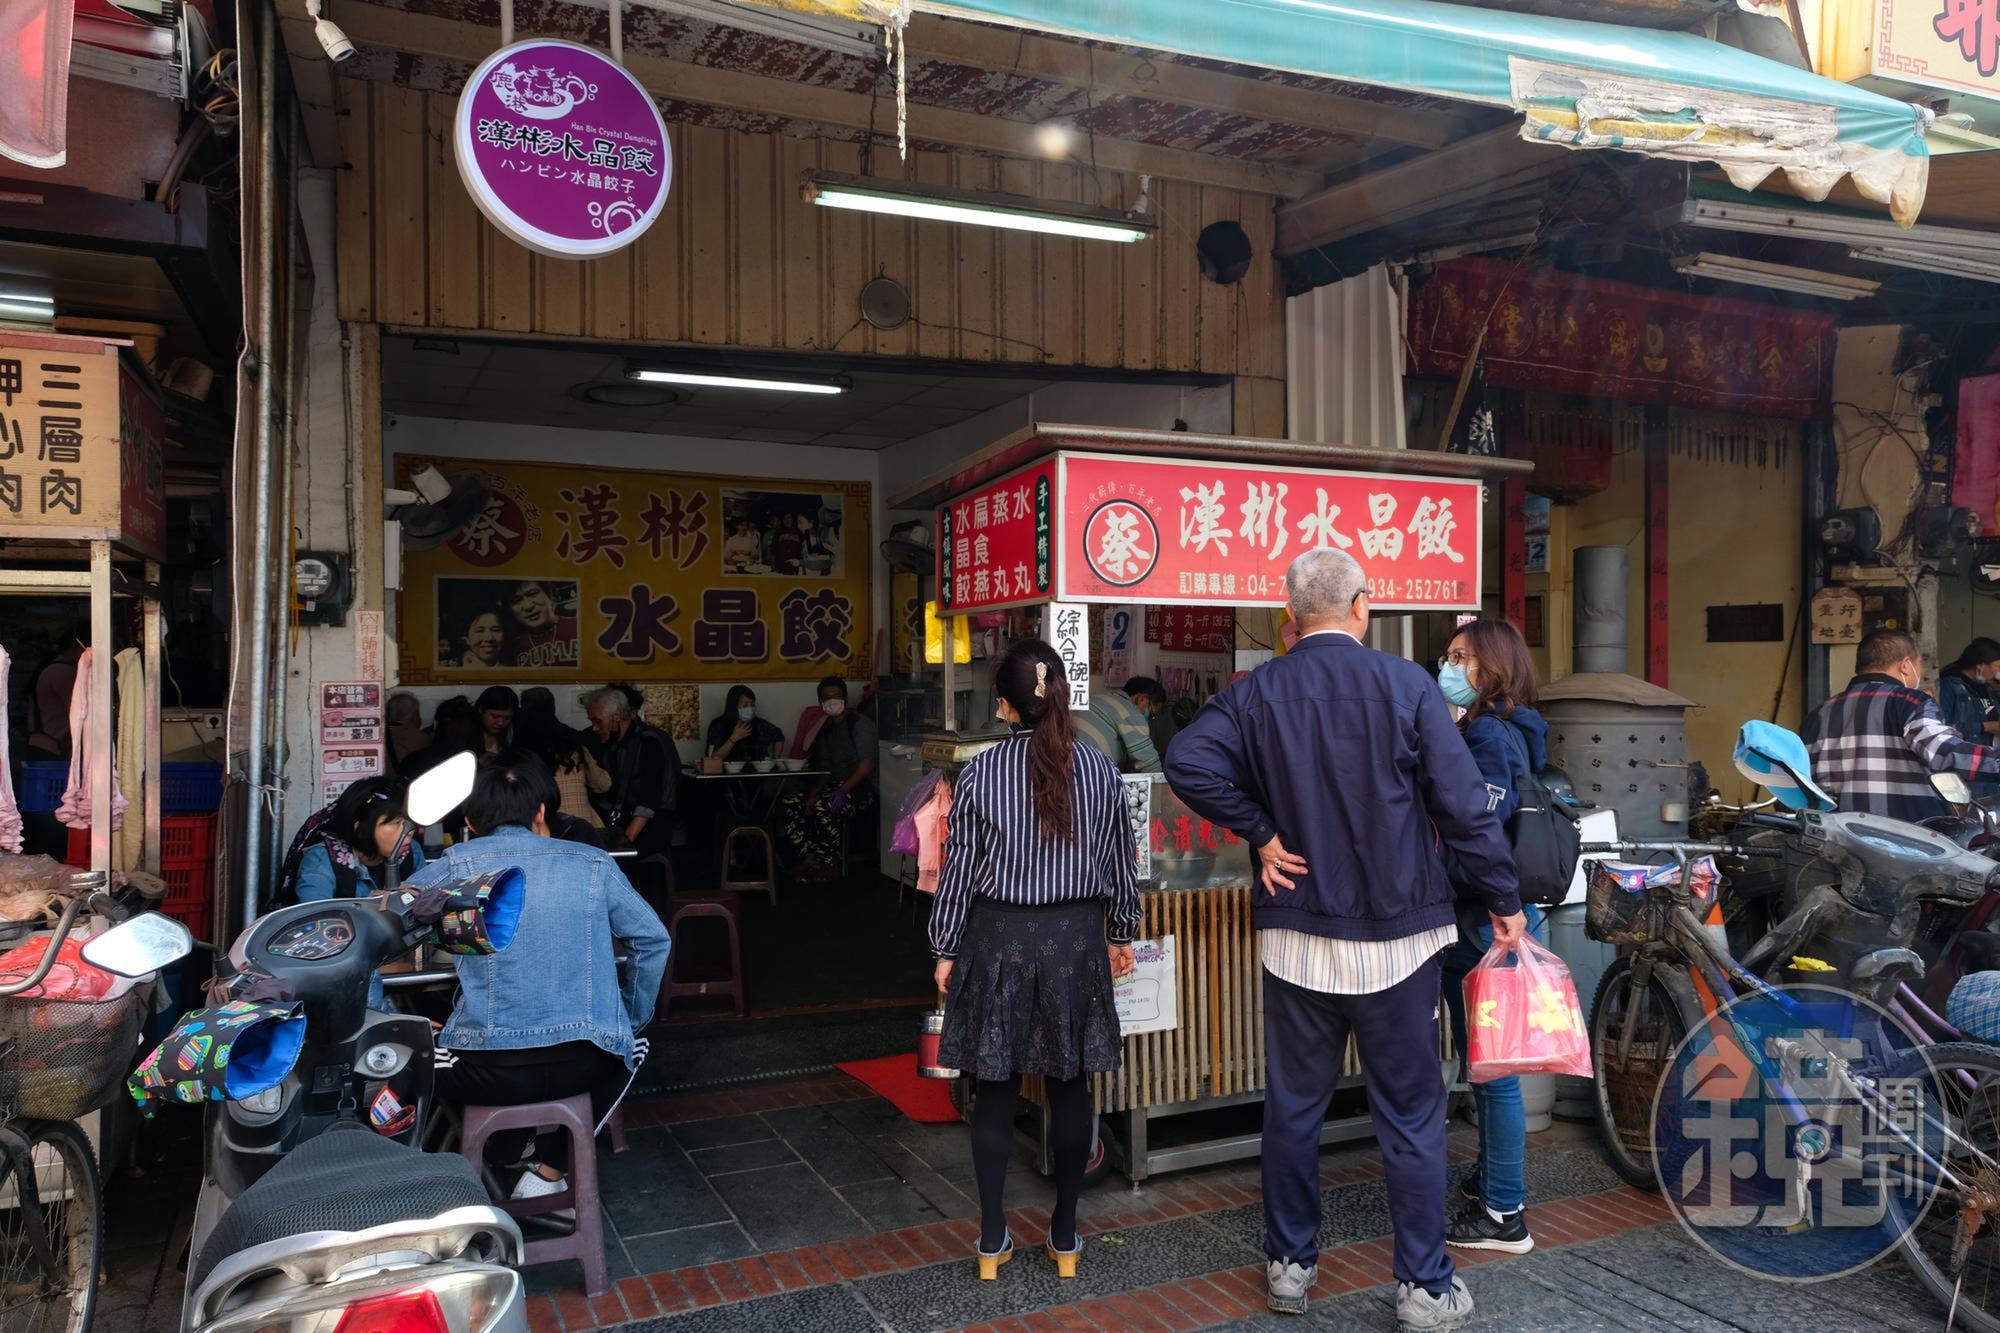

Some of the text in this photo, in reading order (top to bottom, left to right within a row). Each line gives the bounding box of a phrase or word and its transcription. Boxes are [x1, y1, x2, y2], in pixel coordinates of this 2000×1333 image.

[478, 119, 657, 176] 漢彬水晶餃
[599, 127, 623, 139] Crystal
[500, 159, 636, 194] ハンビン水晶餃子
[38, 363, 83, 515] 三層肉
[552, 483, 710, 569] 漢彬
[955, 503, 971, 604] 水晶餃
[1037, 481, 1050, 586] 手工精製
[1097, 509, 1152, 579] 蔡
[1178, 479, 1465, 564] 漢彬水晶餃
[596, 583, 854, 664] 水晶餃
[1112, 611, 1130, 650] 2
